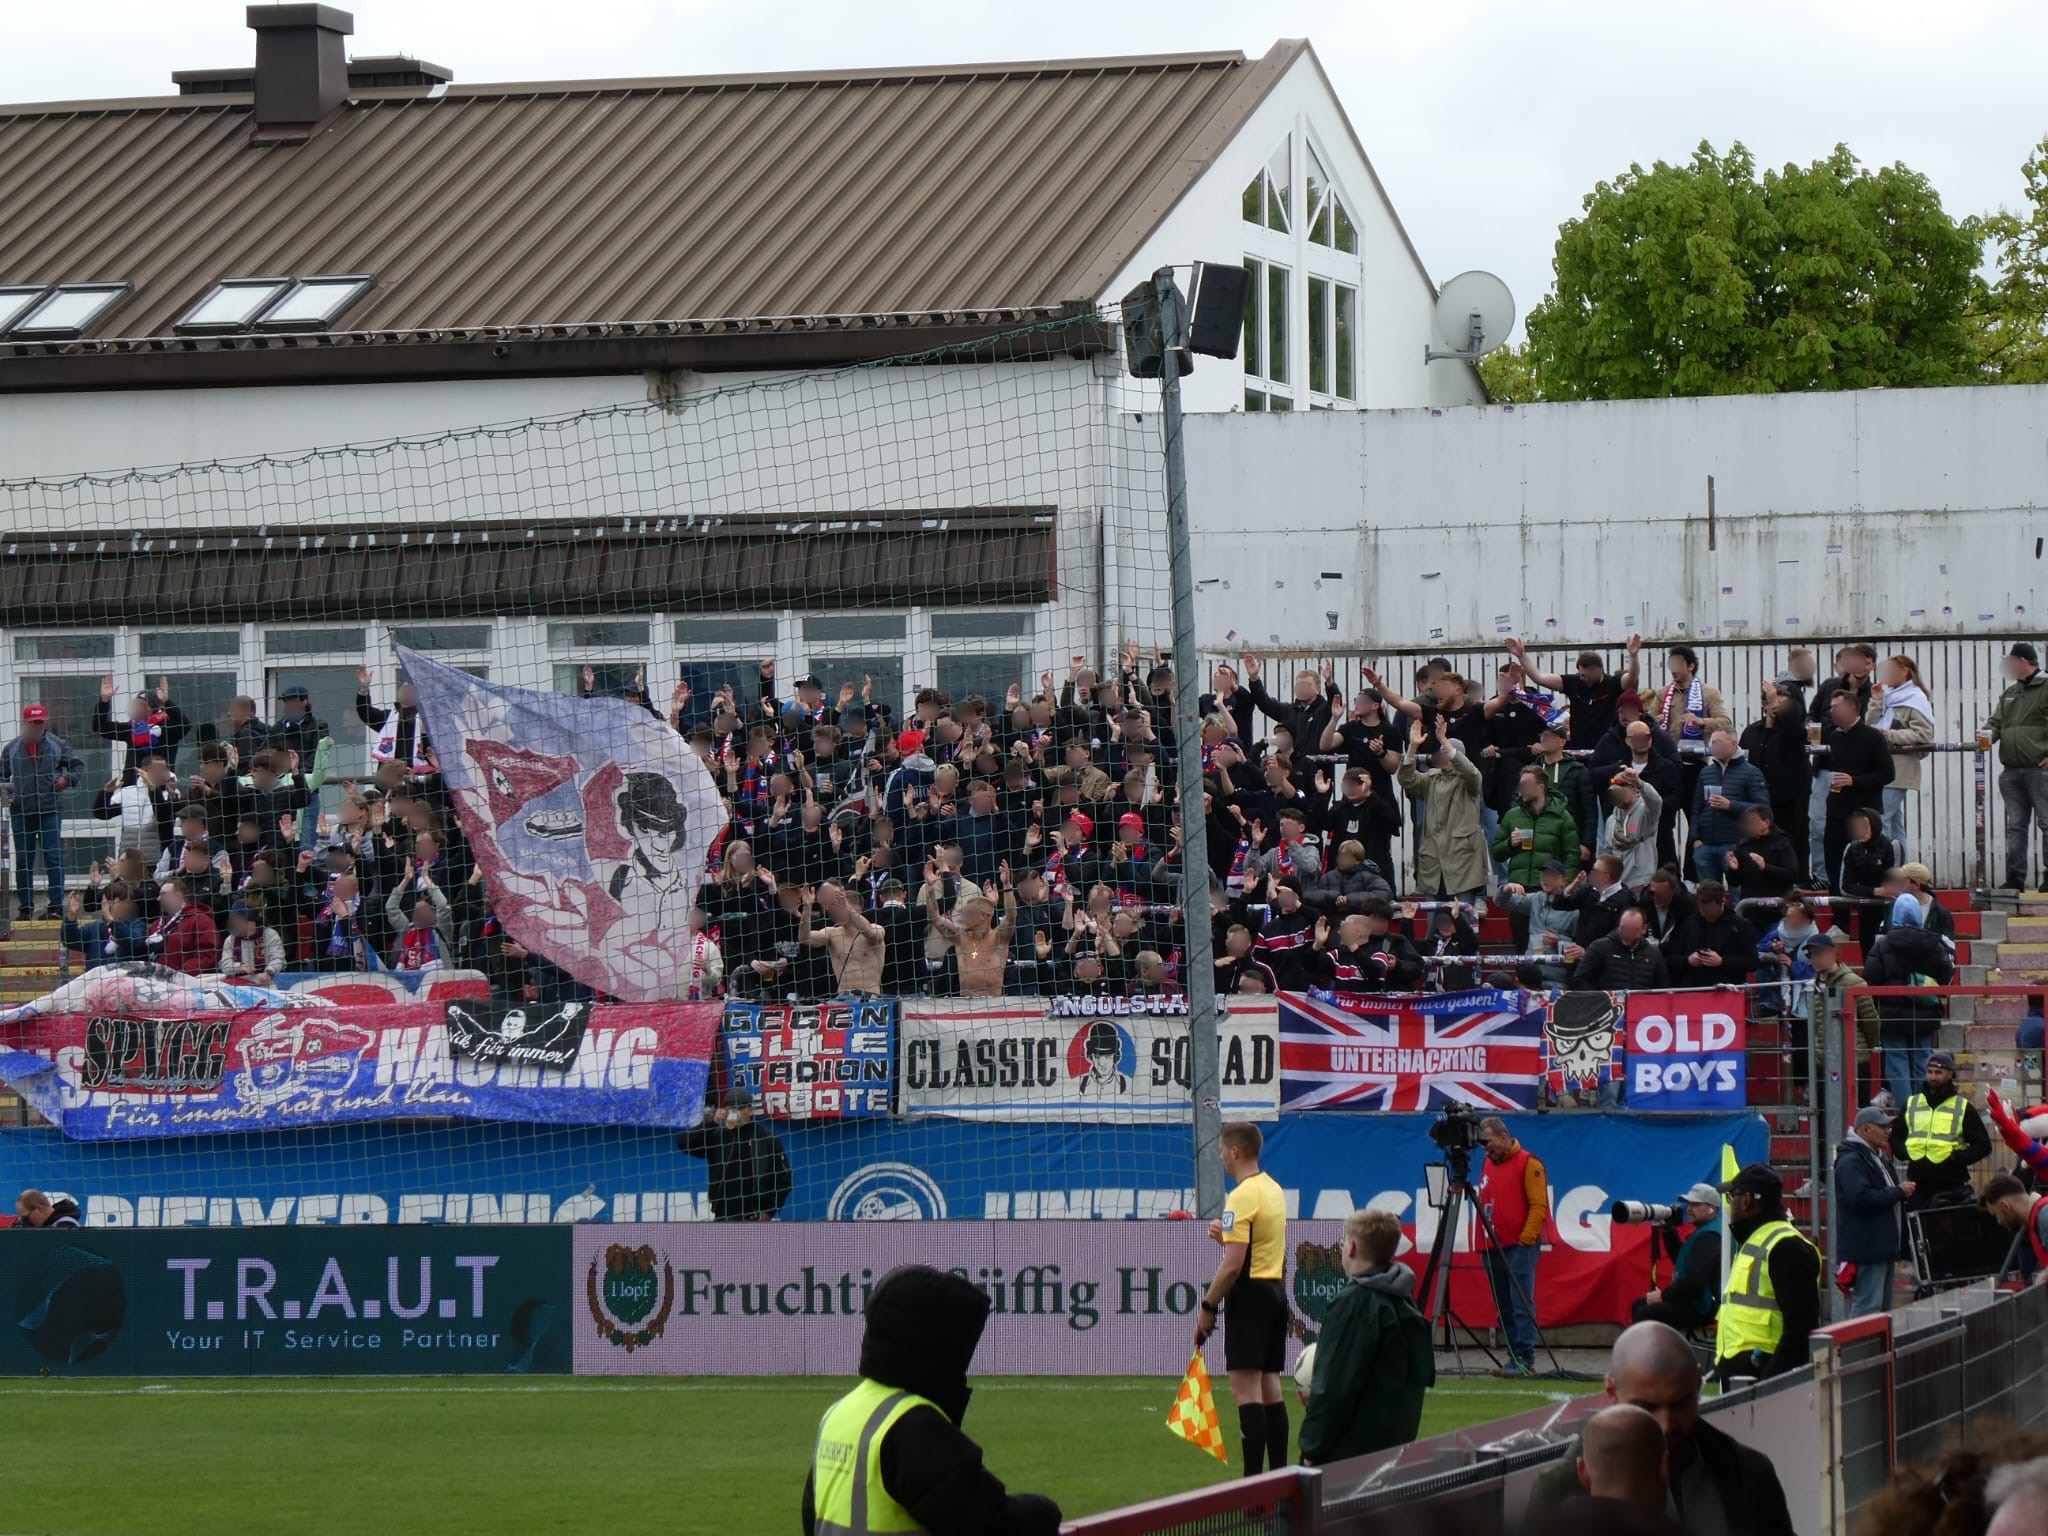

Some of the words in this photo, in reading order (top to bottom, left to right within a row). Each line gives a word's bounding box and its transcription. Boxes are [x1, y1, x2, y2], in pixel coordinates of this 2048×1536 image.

[1051, 993, 1191, 1016] INGOLSTA
[1335, 994, 1358, 1008] Für
[1360, 997, 1404, 1010] immer
[1409, 992, 1498, 1012] unvergessen!
[722, 1004, 889, 1033] GEGEN
[1635, 1013, 1737, 1053] OLD
[470, 1036, 505, 1057] für
[508, 1044, 575, 1064] immer!
[727, 1031, 888, 1060] ALLE
[1330, 1046, 1487, 1073] UNTERHACHING
[731, 1058, 889, 1088] STADION
[906, 1037, 1057, 1089] CLASSIC
[1152, 1034, 1275, 1090] SQAD
[1635, 1060, 1737, 1093] BOYS
[107, 1100, 160, 1129] Für
[172, 1102, 267, 1124] immer
[278, 1092, 322, 1114] rot
[333, 1083, 395, 1109] und
[750, 1088, 889, 1116] ERBOTE
[167, 1256, 500, 1320] T.R.A.U.T
[678, 1265, 873, 1317] Fruchti
[951, 1264, 1099, 1331] üffig
[1116, 1267, 1212, 1315] Ho
[166, 1330, 224, 1350] Your
[243, 1330, 265, 1349] IT
[285, 1329, 382, 1348] Service
[402, 1329, 501, 1348] Partner
